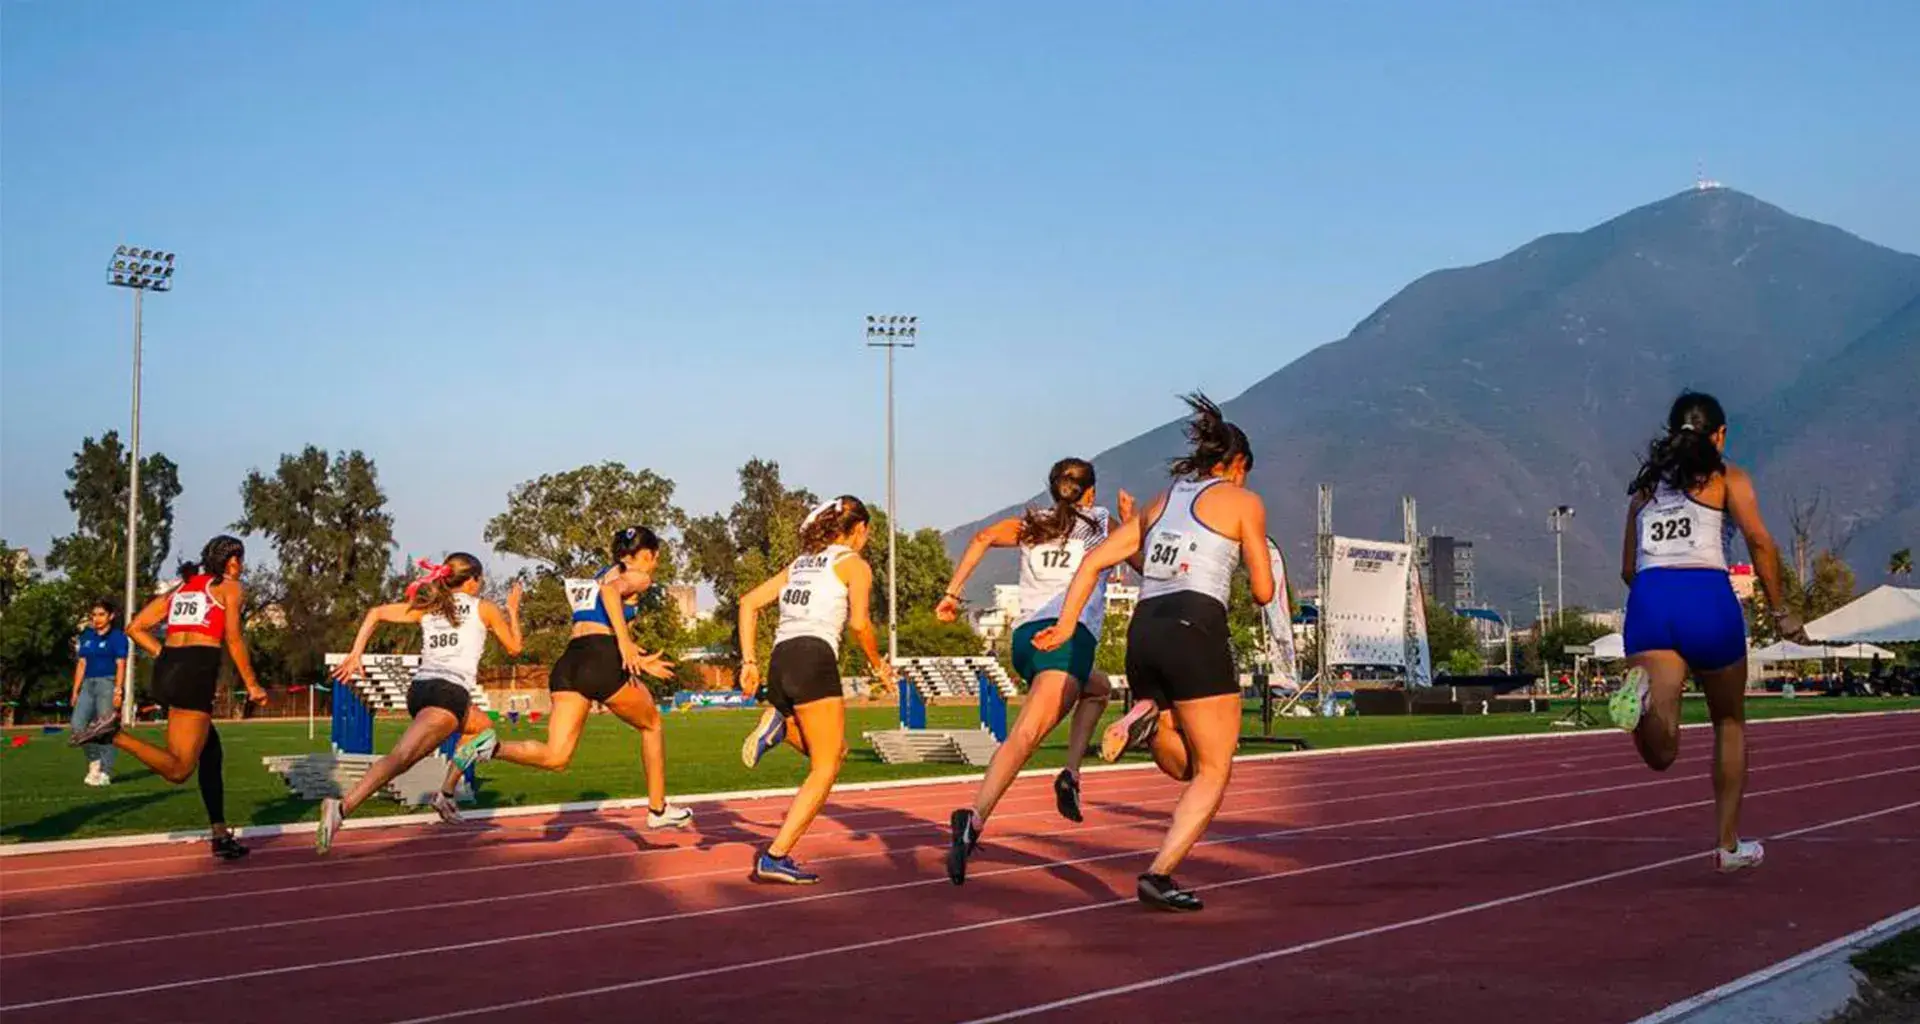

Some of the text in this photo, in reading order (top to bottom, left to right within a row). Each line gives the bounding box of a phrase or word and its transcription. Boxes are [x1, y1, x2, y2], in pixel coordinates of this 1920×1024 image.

[1651, 517, 1692, 541] 323
[1041, 550, 1071, 568] 172
[1150, 543, 1179, 565] 341
[782, 589, 811, 606] 408
[173, 602, 198, 616] 376
[429, 633, 459, 648] 386
